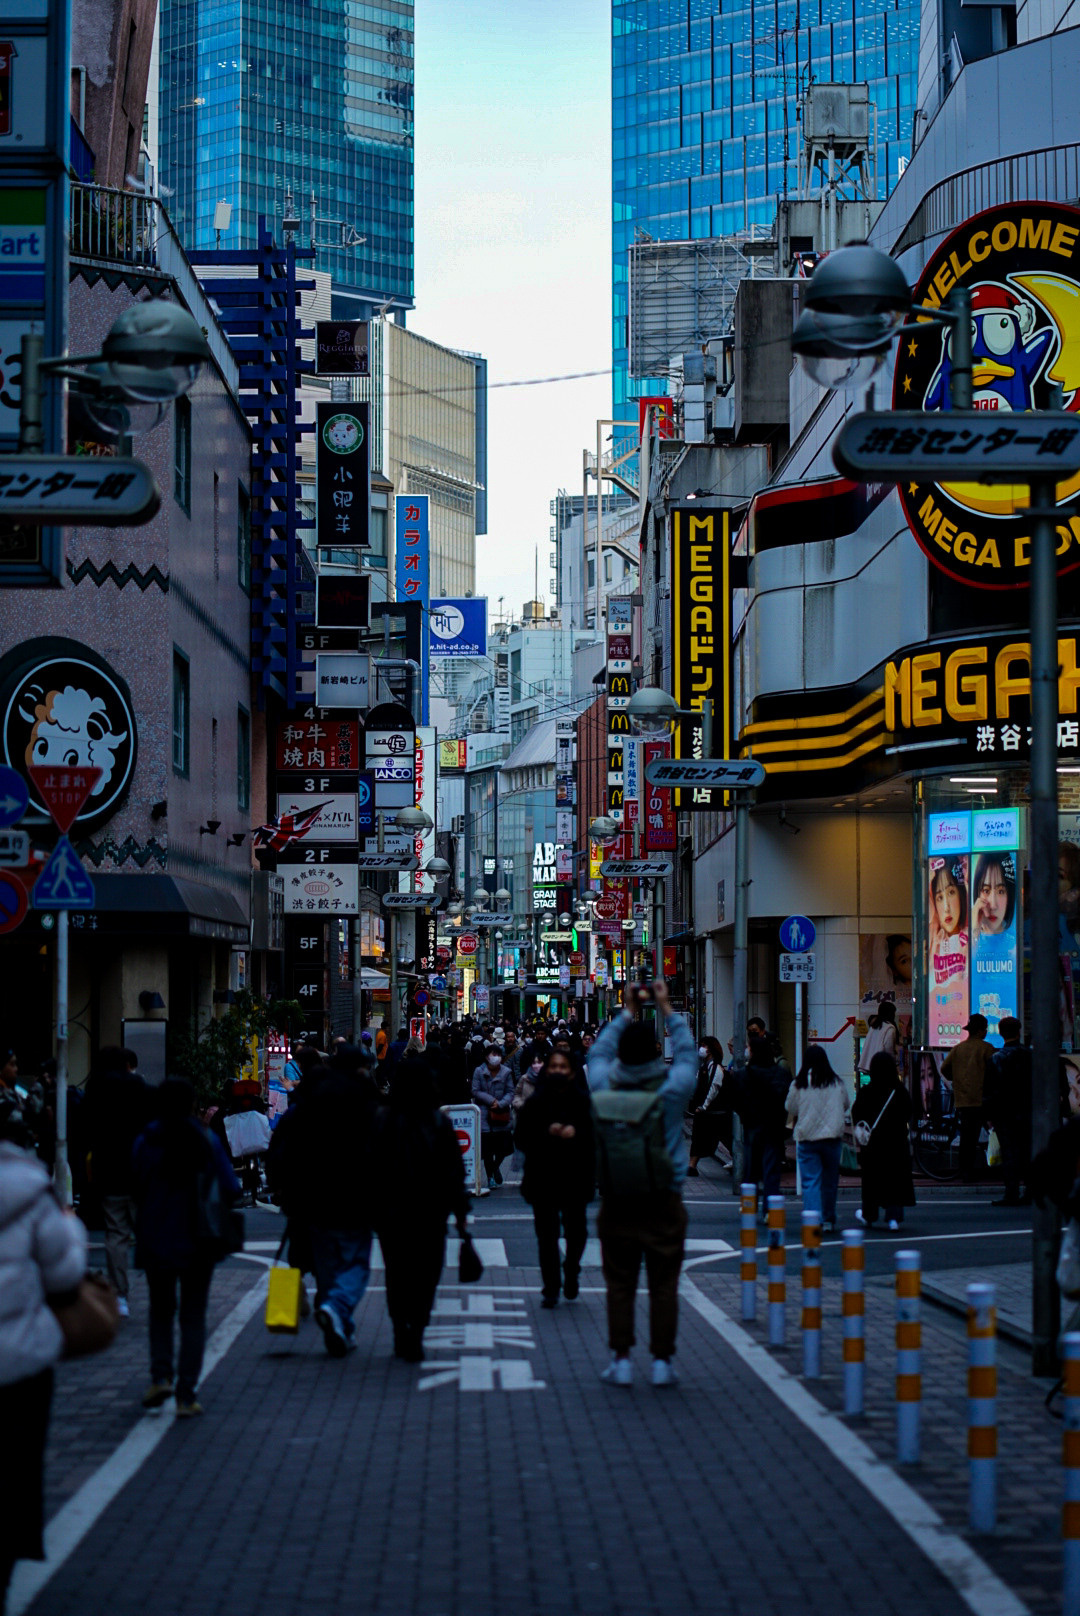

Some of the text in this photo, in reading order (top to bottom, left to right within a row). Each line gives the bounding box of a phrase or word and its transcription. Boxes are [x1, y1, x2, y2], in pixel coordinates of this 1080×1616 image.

[0, 232, 39, 256] art
[916, 218, 1080, 323] WELCOME
[333, 466, 353, 534] 小肥羊
[917, 494, 1001, 568] MEGA
[404, 504, 421, 596] カラオケ
[321, 675, 368, 685] 新岩崎ビル
[283, 722, 328, 745] 和牛
[976, 720, 1080, 752] 渋谷店
[283, 746, 327, 768] 焼肉
[653, 766, 757, 781] 渋谷センター街
[51, 793, 81, 803] STOP
[606, 863, 669, 873] 渋谷センター街
[292, 898, 342, 910] 渋谷餃子
[300, 938, 318, 949] 5F
[783, 955, 791, 963] 15
[807, 955, 813, 963] 5
[976, 960, 1013, 973] ULULUMO
[807, 972, 813, 980] 5
[299, 984, 318, 997] 4F
